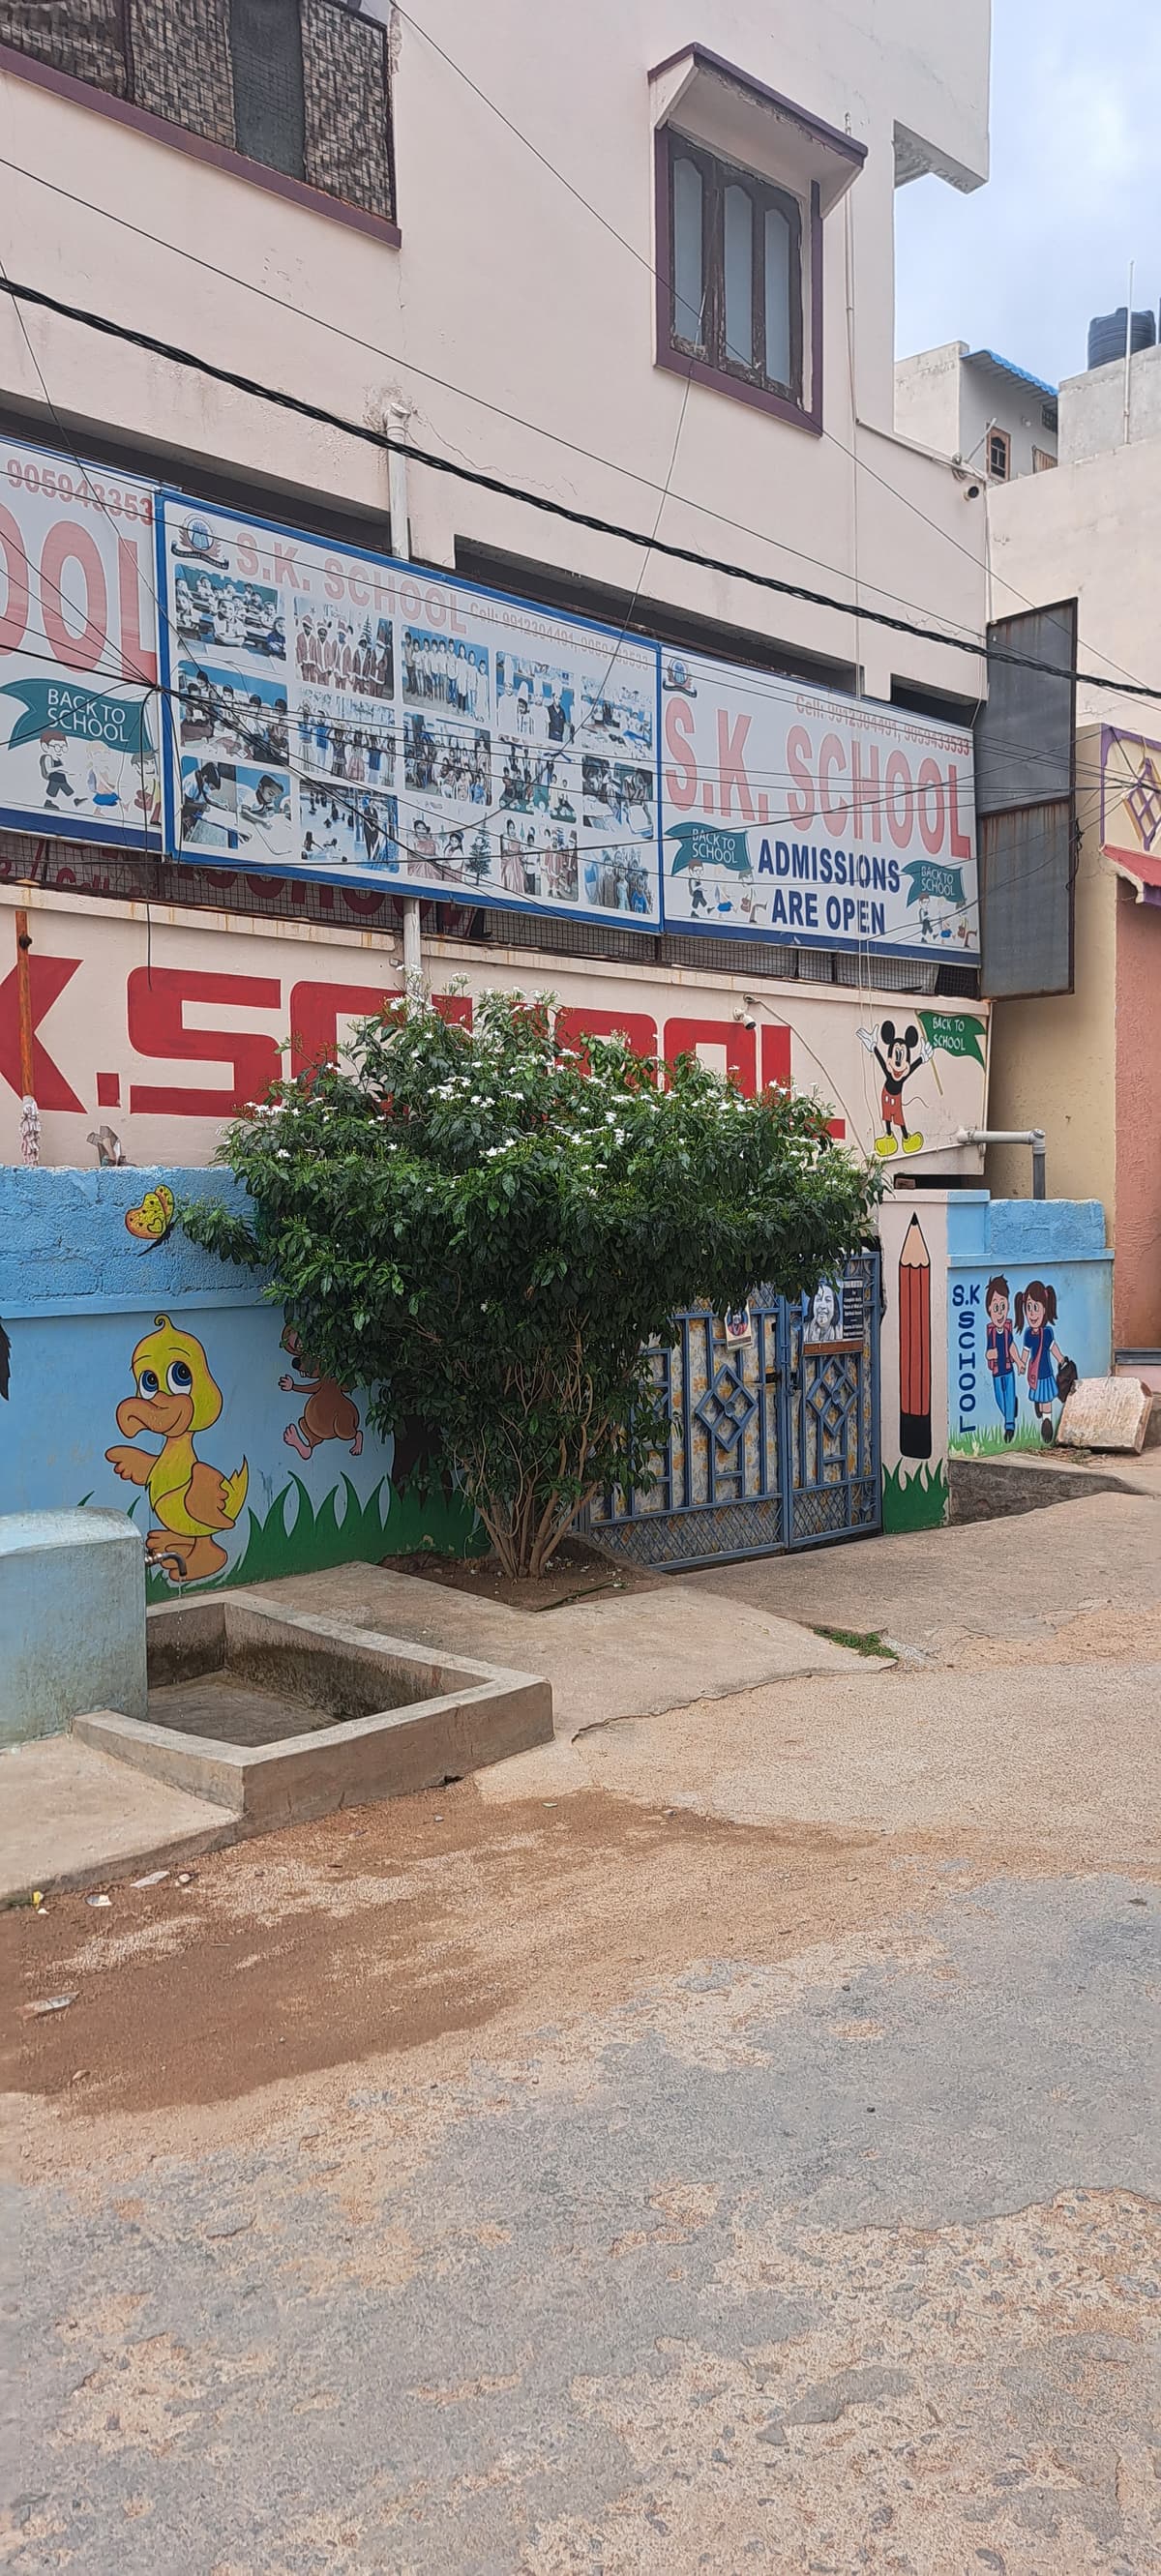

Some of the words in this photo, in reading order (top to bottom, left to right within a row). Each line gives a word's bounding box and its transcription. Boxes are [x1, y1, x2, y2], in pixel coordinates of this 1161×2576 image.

[236, 532, 311, 592] S.K.
[323, 557, 467, 635] SCHOOL
[47, 688, 98, 719] BACK
[101, 703, 126, 724] TO
[47, 707, 129, 742] SCHOOL
[665, 697, 769, 822] S.K.
[787, 725, 972, 859] SCHOOL
[692, 828, 722, 848] BACK
[722, 835, 735, 849] TO
[692, 842, 738, 864] SCHOOL
[758, 839, 901, 893] ADMISSIONS
[921, 866, 942, 882] BACK
[942, 873, 954, 884] TO
[921, 878, 956, 897] SCHOOL
[772, 889, 819, 928] ARE
[825, 896, 885, 935] OPEN
[932, 1017, 952, 1031] BACK
[954, 1019, 965, 1032] TO
[933, 1033, 966, 1051] SCHOOL
[952, 1285, 980, 1307] S.K
[958, 1311, 976, 1433] SCHOOL
